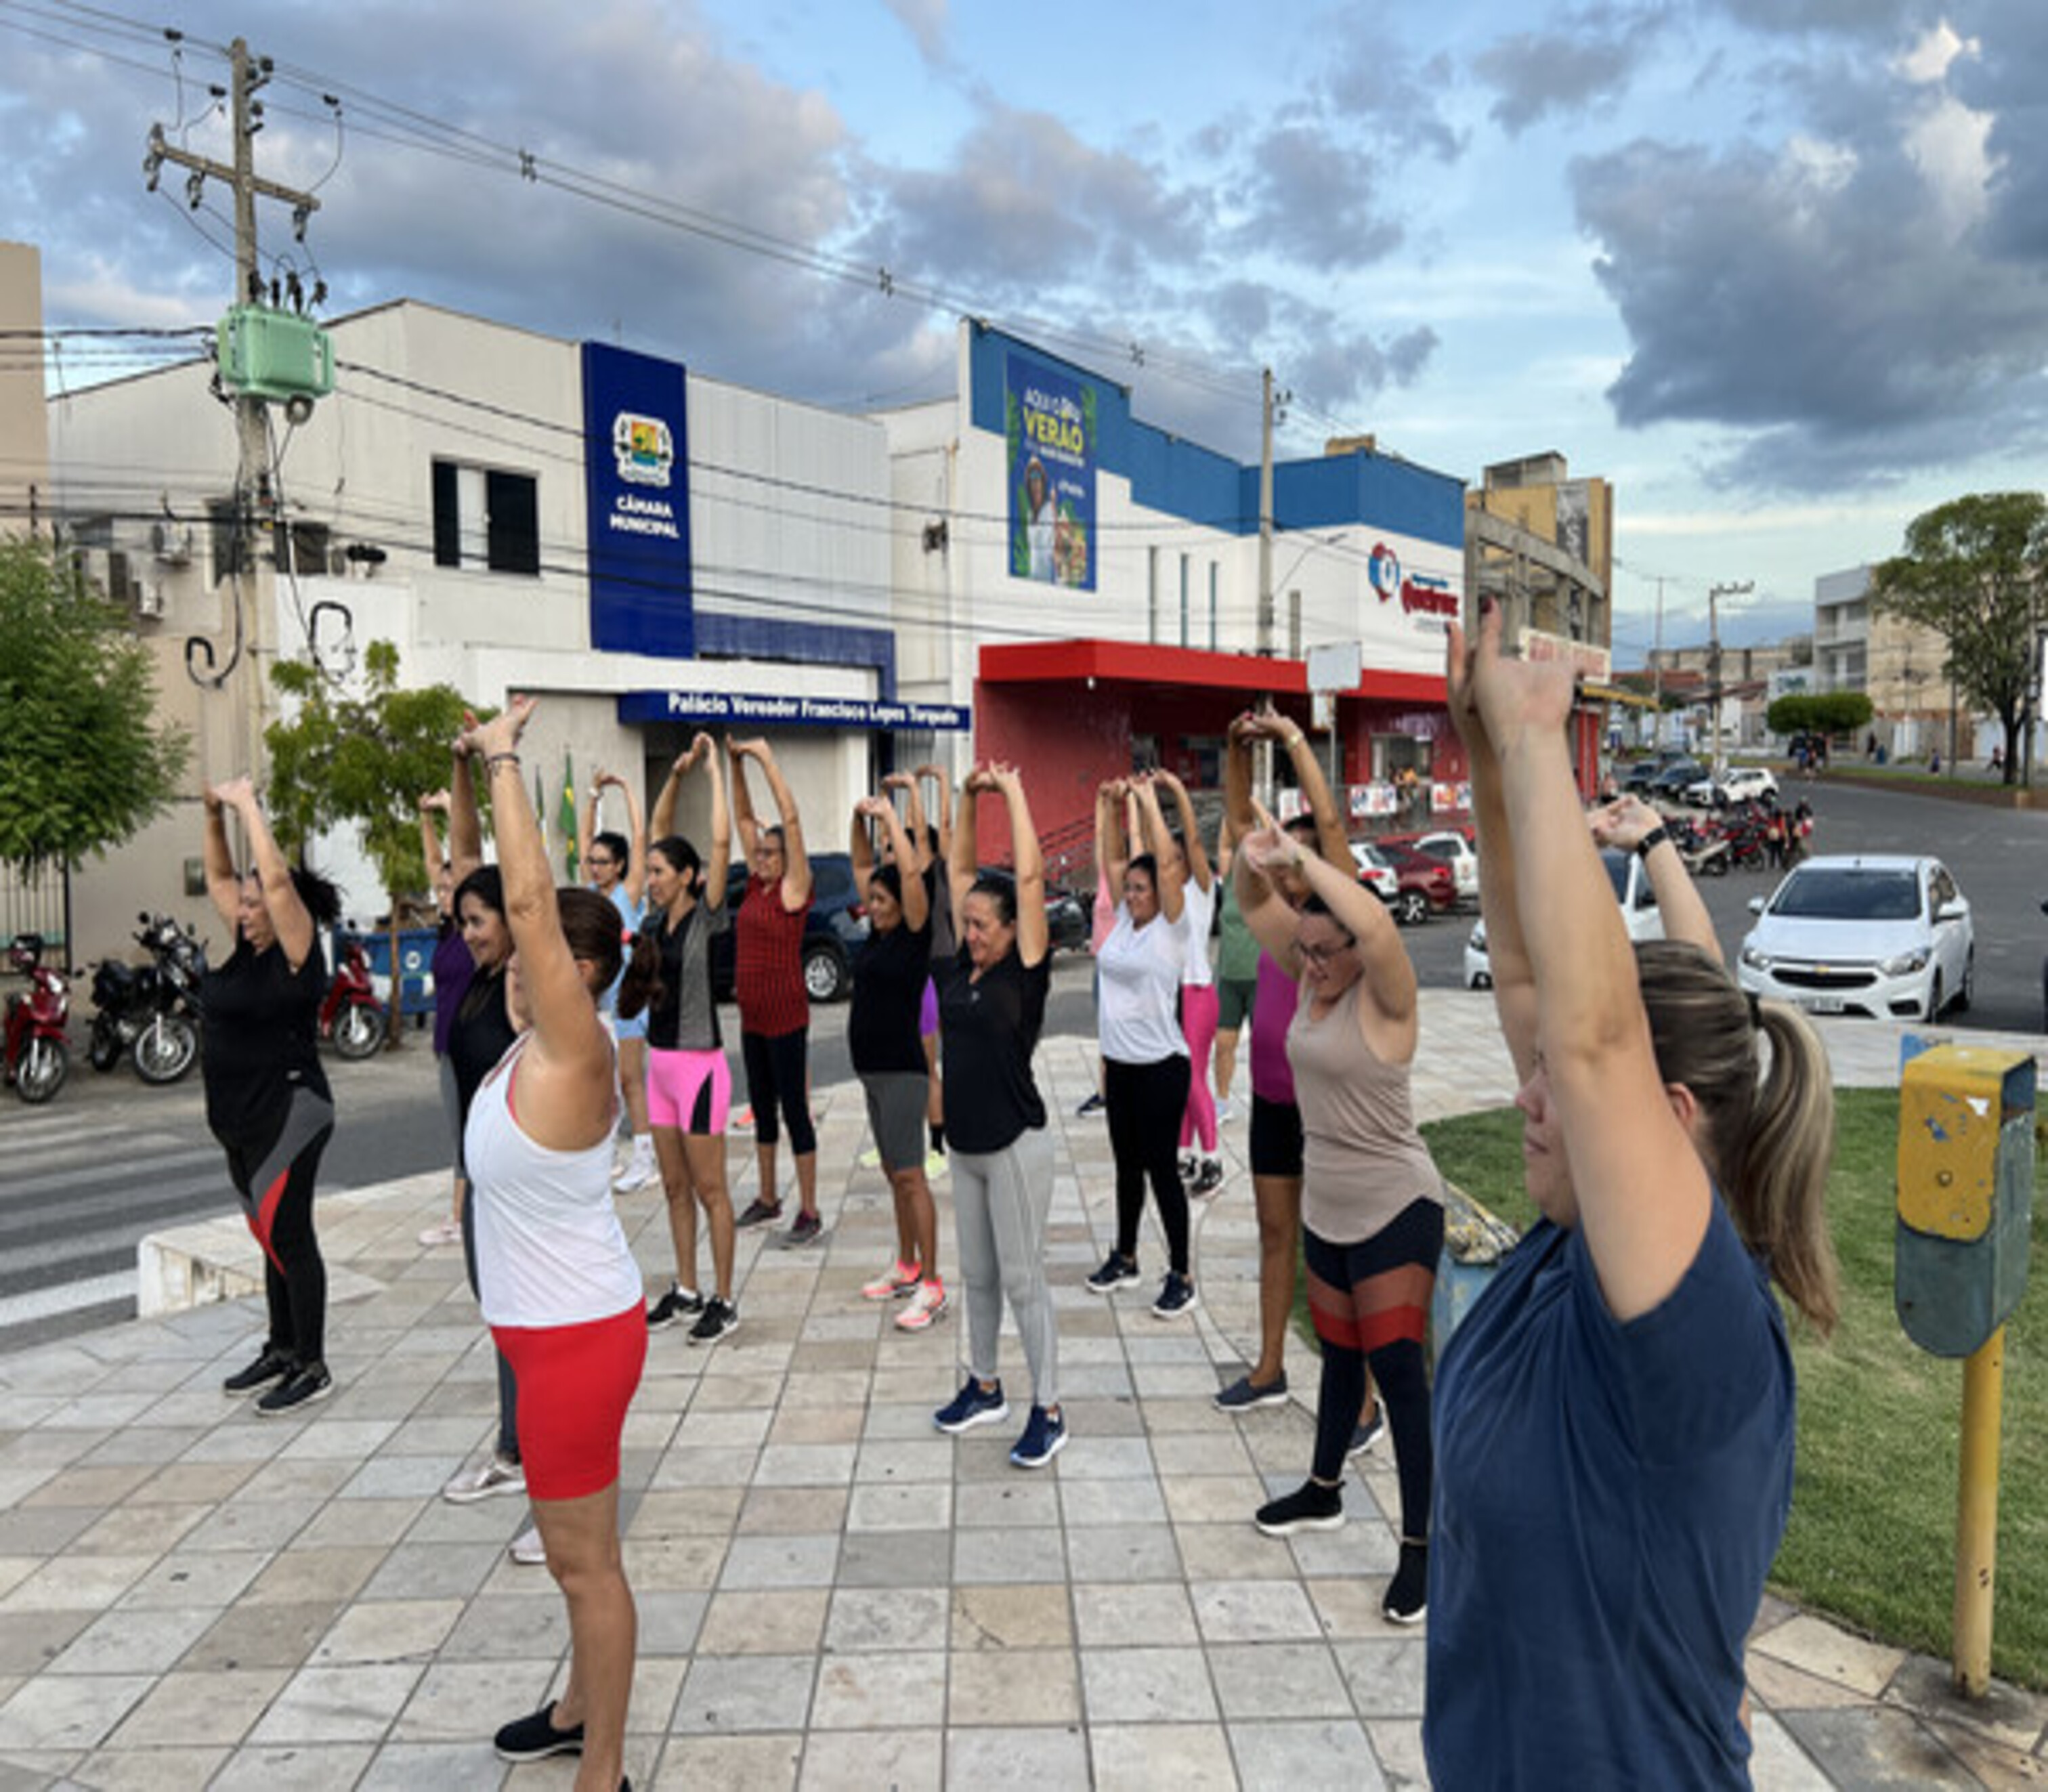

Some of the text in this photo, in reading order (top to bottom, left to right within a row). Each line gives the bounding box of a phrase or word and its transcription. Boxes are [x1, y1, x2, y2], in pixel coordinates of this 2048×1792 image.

[1024, 406, 1083, 455] VERÃO
[616, 494, 674, 519] CÂMARA
[610, 513, 680, 539] MUNICIPAL
[668, 691, 728, 715] Palácio
[730, 696, 799, 718] Vereador
[802, 699, 866, 722] Francisco
[870, 703, 906, 725] Lopes
